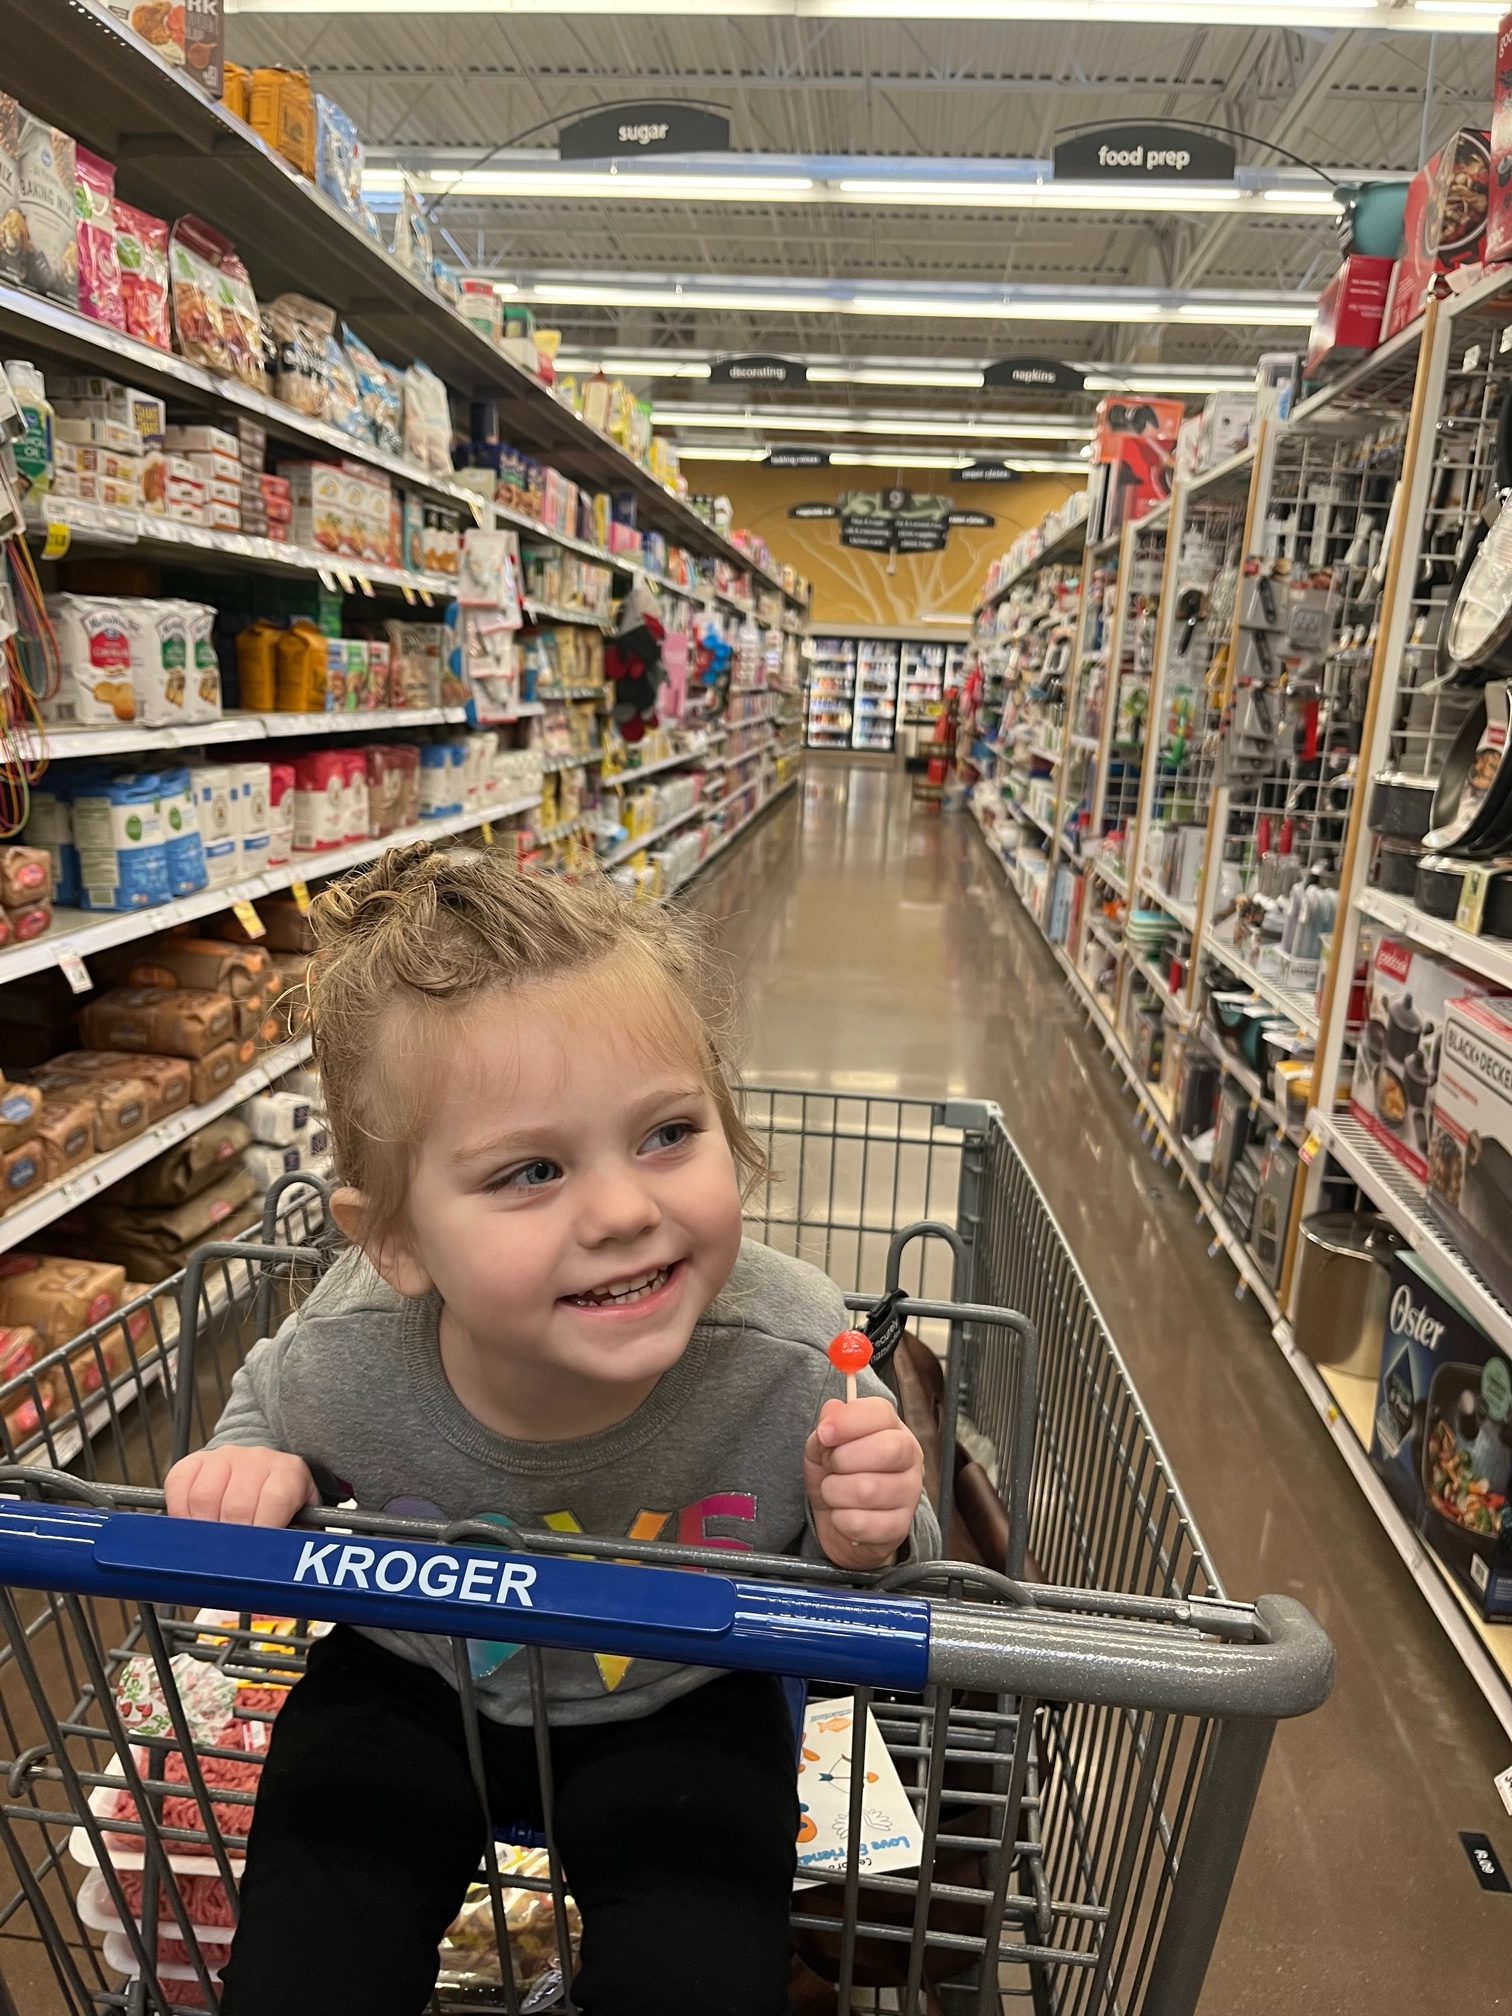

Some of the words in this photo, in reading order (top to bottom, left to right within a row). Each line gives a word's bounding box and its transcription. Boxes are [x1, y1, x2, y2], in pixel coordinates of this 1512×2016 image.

[618, 123, 670, 145] sugar
[1098, 145, 1144, 166] food
[1146, 150, 1191, 171] prep
[729, 365, 787, 381] decorating
[1011, 368, 1057, 384] napkins
[1389, 1284, 1446, 1351] Oster
[293, 1541, 537, 1607] KROGER
[871, 1836, 910, 1850] Love
